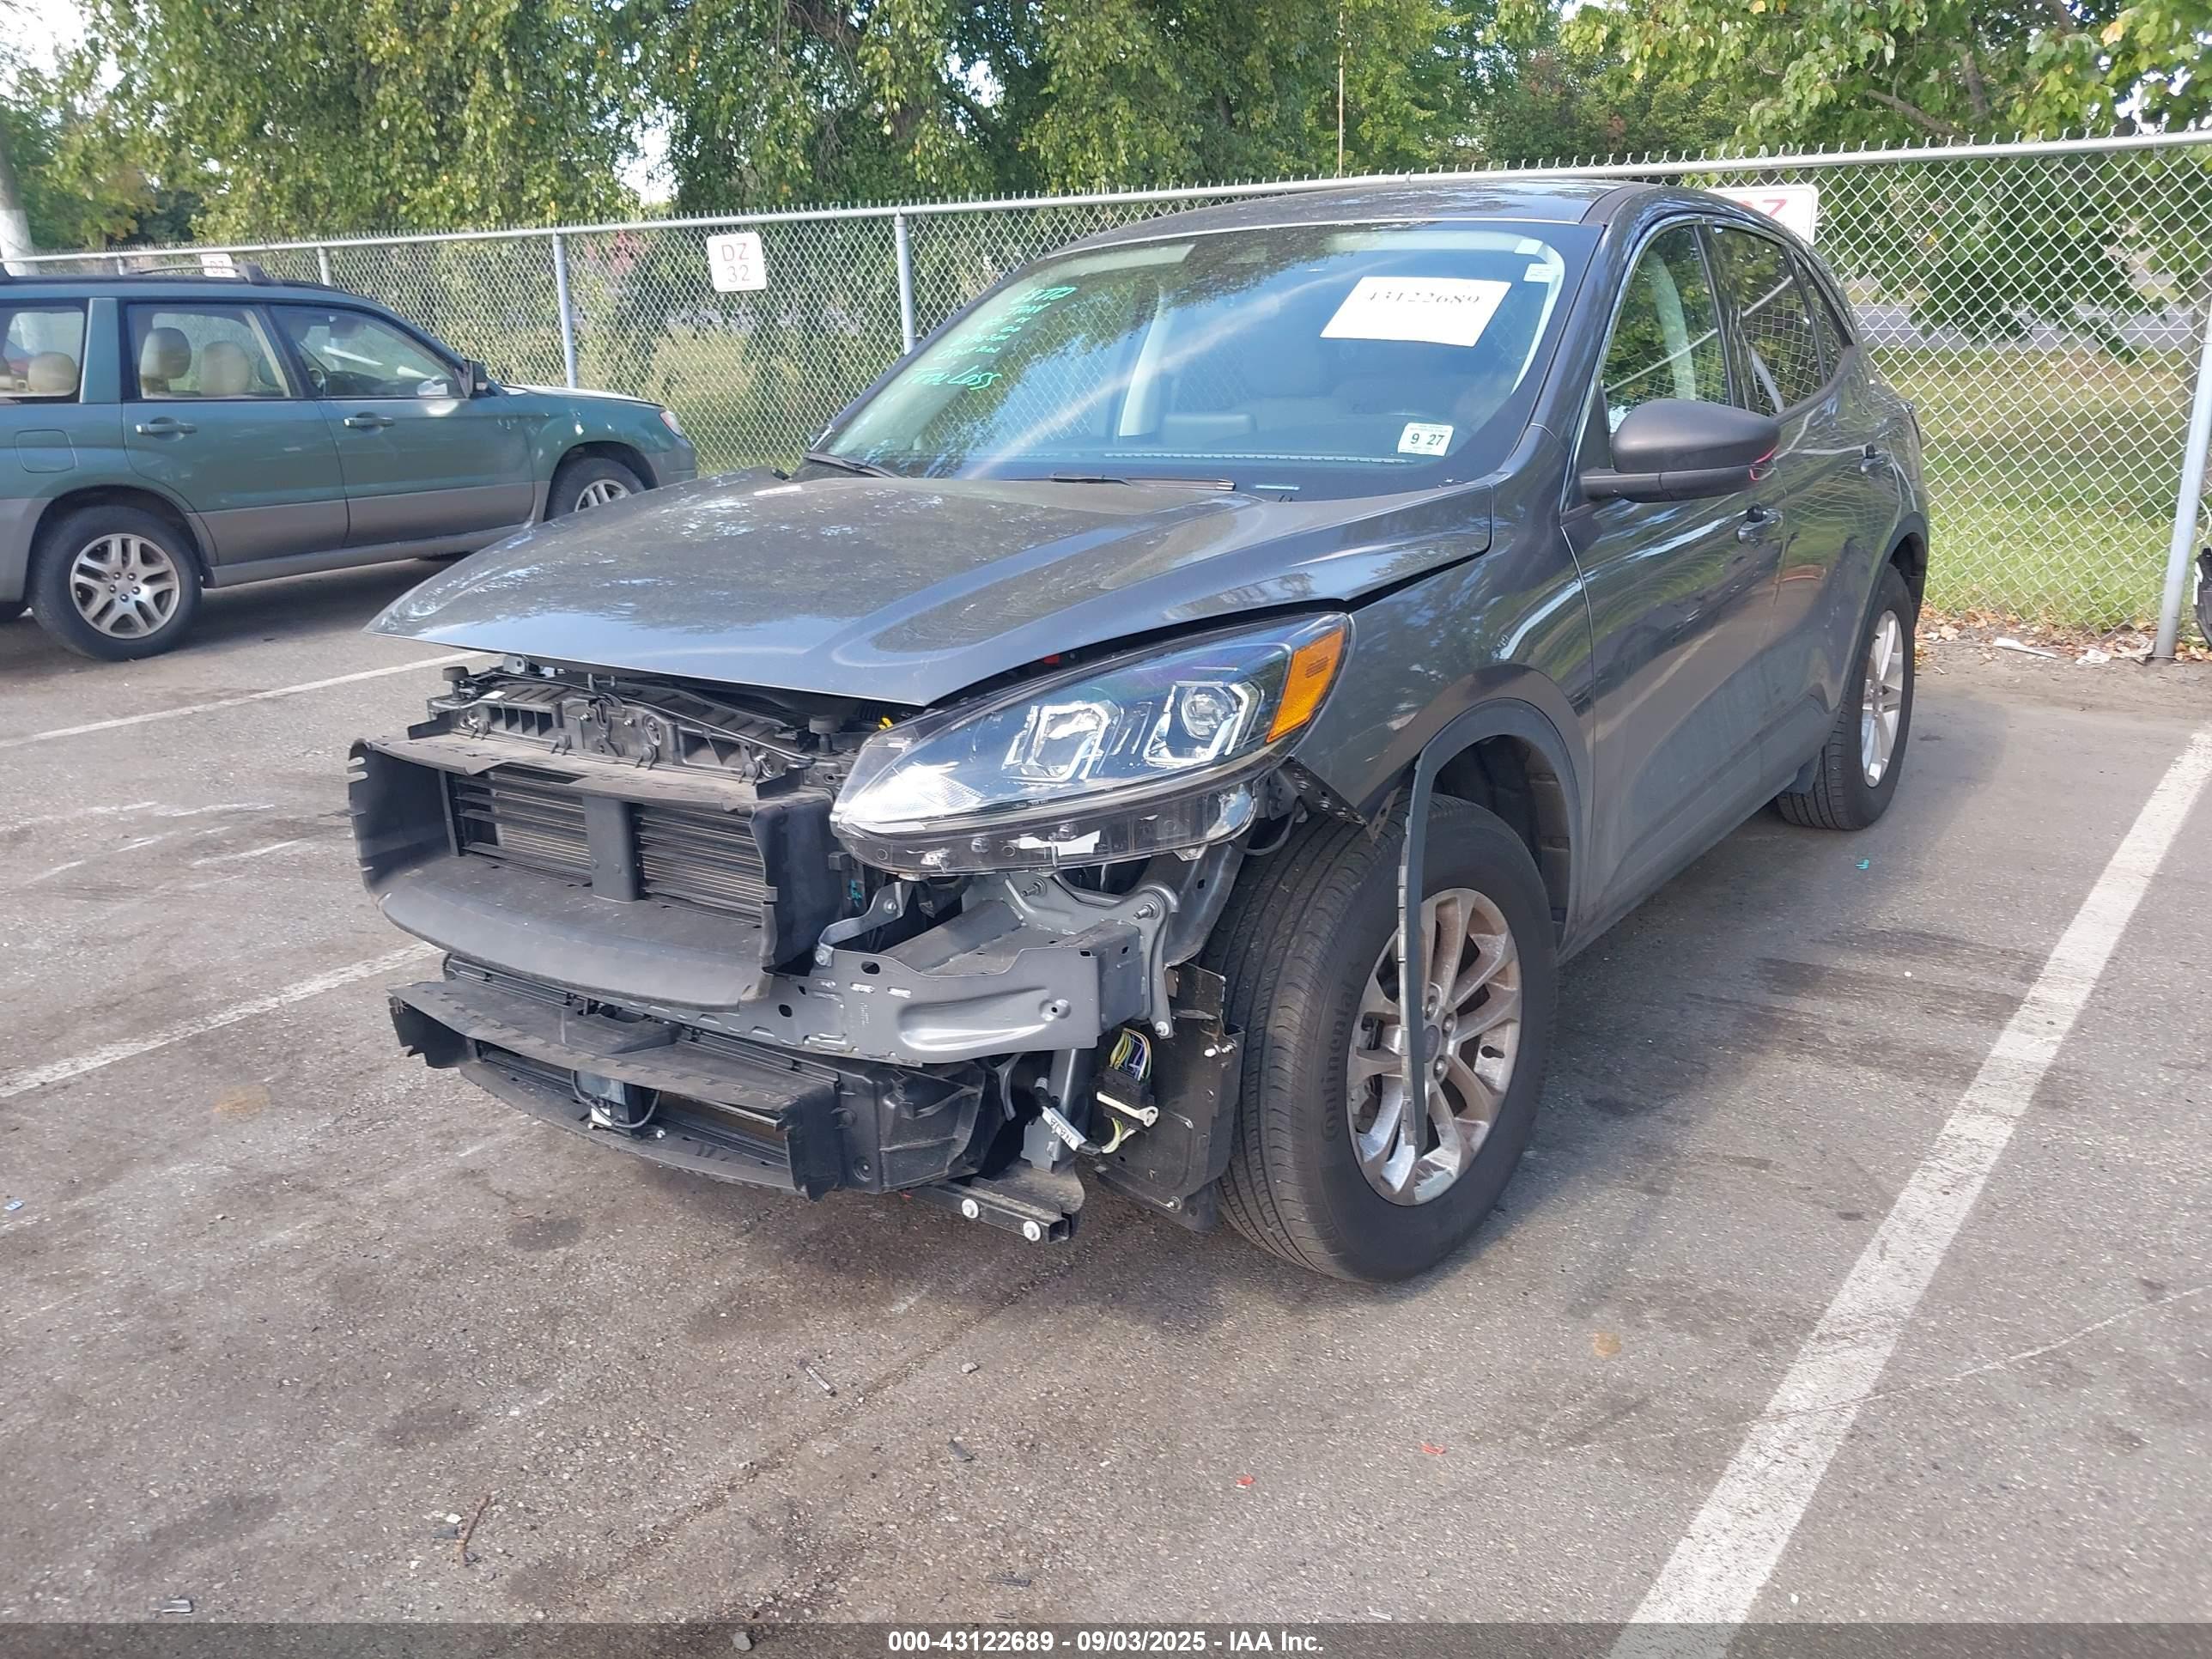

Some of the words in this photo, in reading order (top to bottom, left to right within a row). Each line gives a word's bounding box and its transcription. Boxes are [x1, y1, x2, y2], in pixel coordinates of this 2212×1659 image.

[721, 242, 750, 262] DZ
[726, 264, 751, 283] 32
[1410, 433, 1420, 445] 9
[1426, 434, 1446, 446] 27
